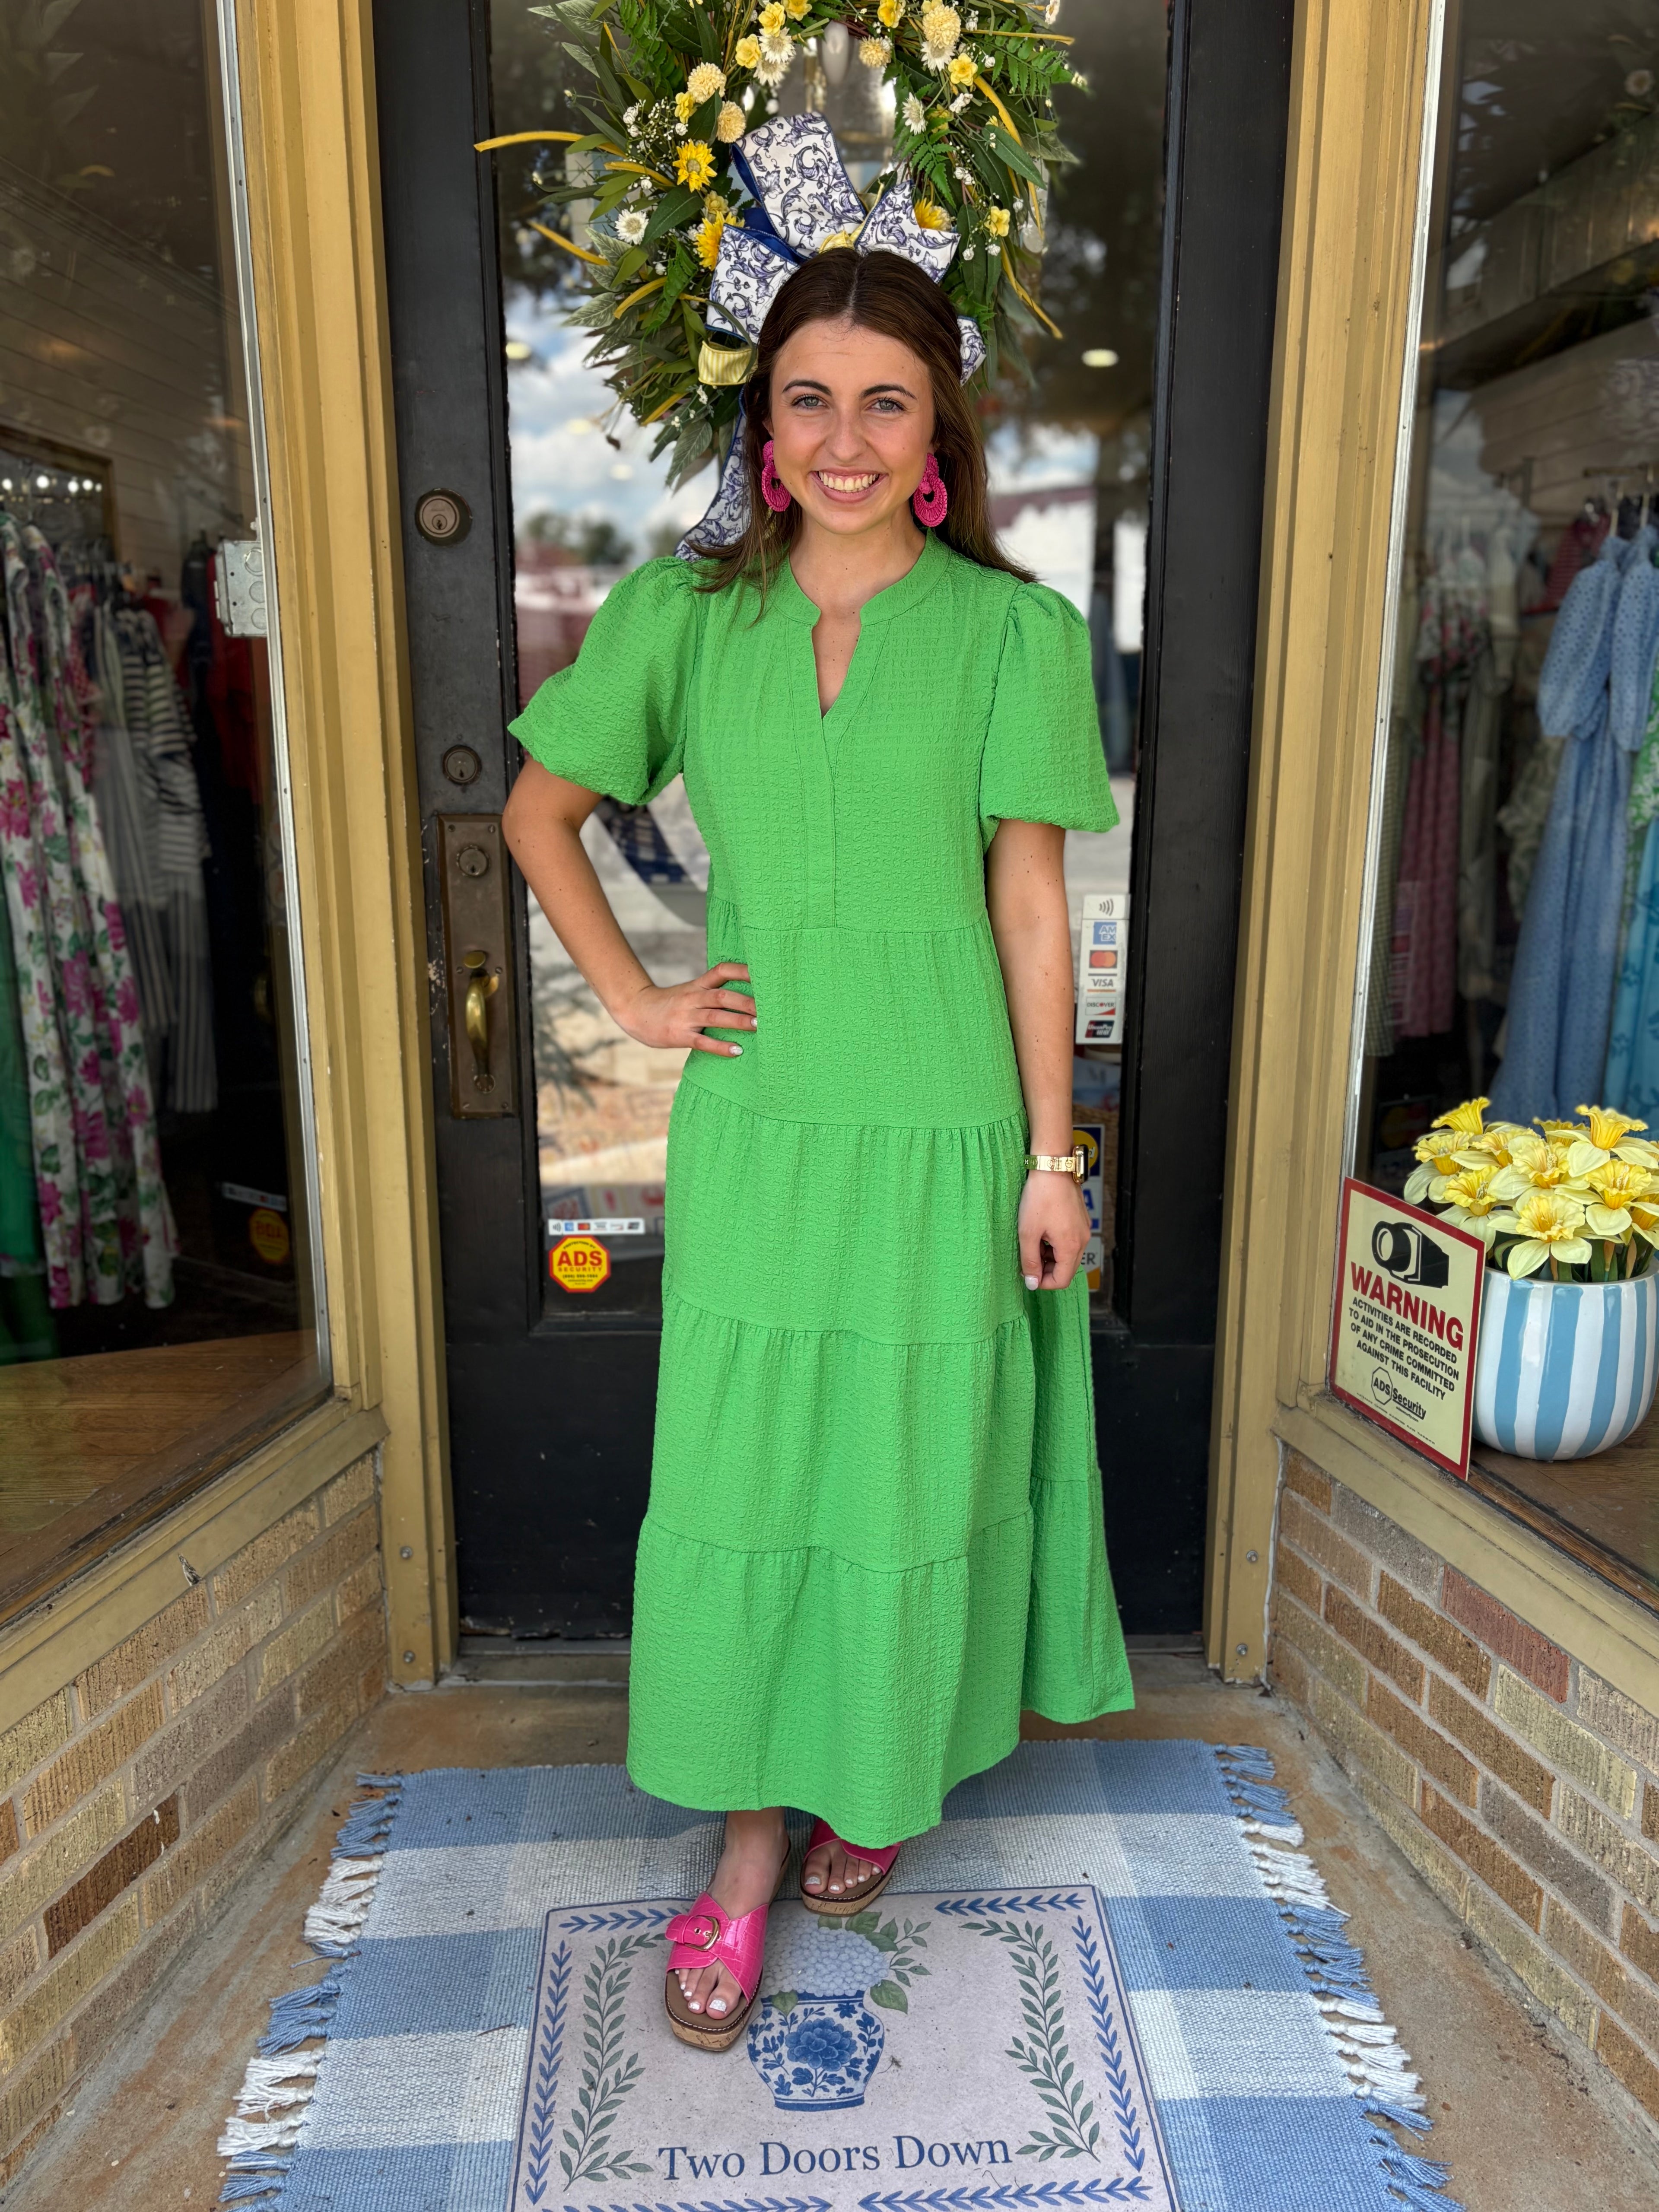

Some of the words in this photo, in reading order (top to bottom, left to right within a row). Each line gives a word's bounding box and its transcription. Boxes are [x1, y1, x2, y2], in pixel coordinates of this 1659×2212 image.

[1091, 979, 1114, 987] VISA
[557, 1250, 602, 1267] ADS
[1351, 1261, 1464, 1352] WARNING
[1352, 1297, 1393, 1326] ACTIVITIES
[1395, 1321, 1411, 1337] ARE
[1413, 1330, 1457, 1364] RECORDED
[1349, 1307, 1359, 1320] TO
[1360, 1315, 1374, 1328] AID
[1376, 1322, 1384, 1335] IN
[1386, 1328, 1401, 1345] THE
[1402, 1338, 1459, 1381] PROSECUTION
[1351, 1322, 1361, 1334] OF
[1362, 1329, 1378, 1344] ANY
[1379, 1339, 1405, 1361] CRIME
[1406, 1355, 1455, 1392] COMMITTED
[1357, 1339, 1390, 1365] AGAINST
[1391, 1359, 1409, 1378] THIS
[1411, 1371, 1446, 1401] FACILITY
[1373, 1377, 1391, 1396] ADS
[1392, 1388, 1427, 1420] Security
[658, 2146, 746, 2181] Two
[759, 2141, 880, 2177] Doors
[892, 2134, 1013, 2170] Down
